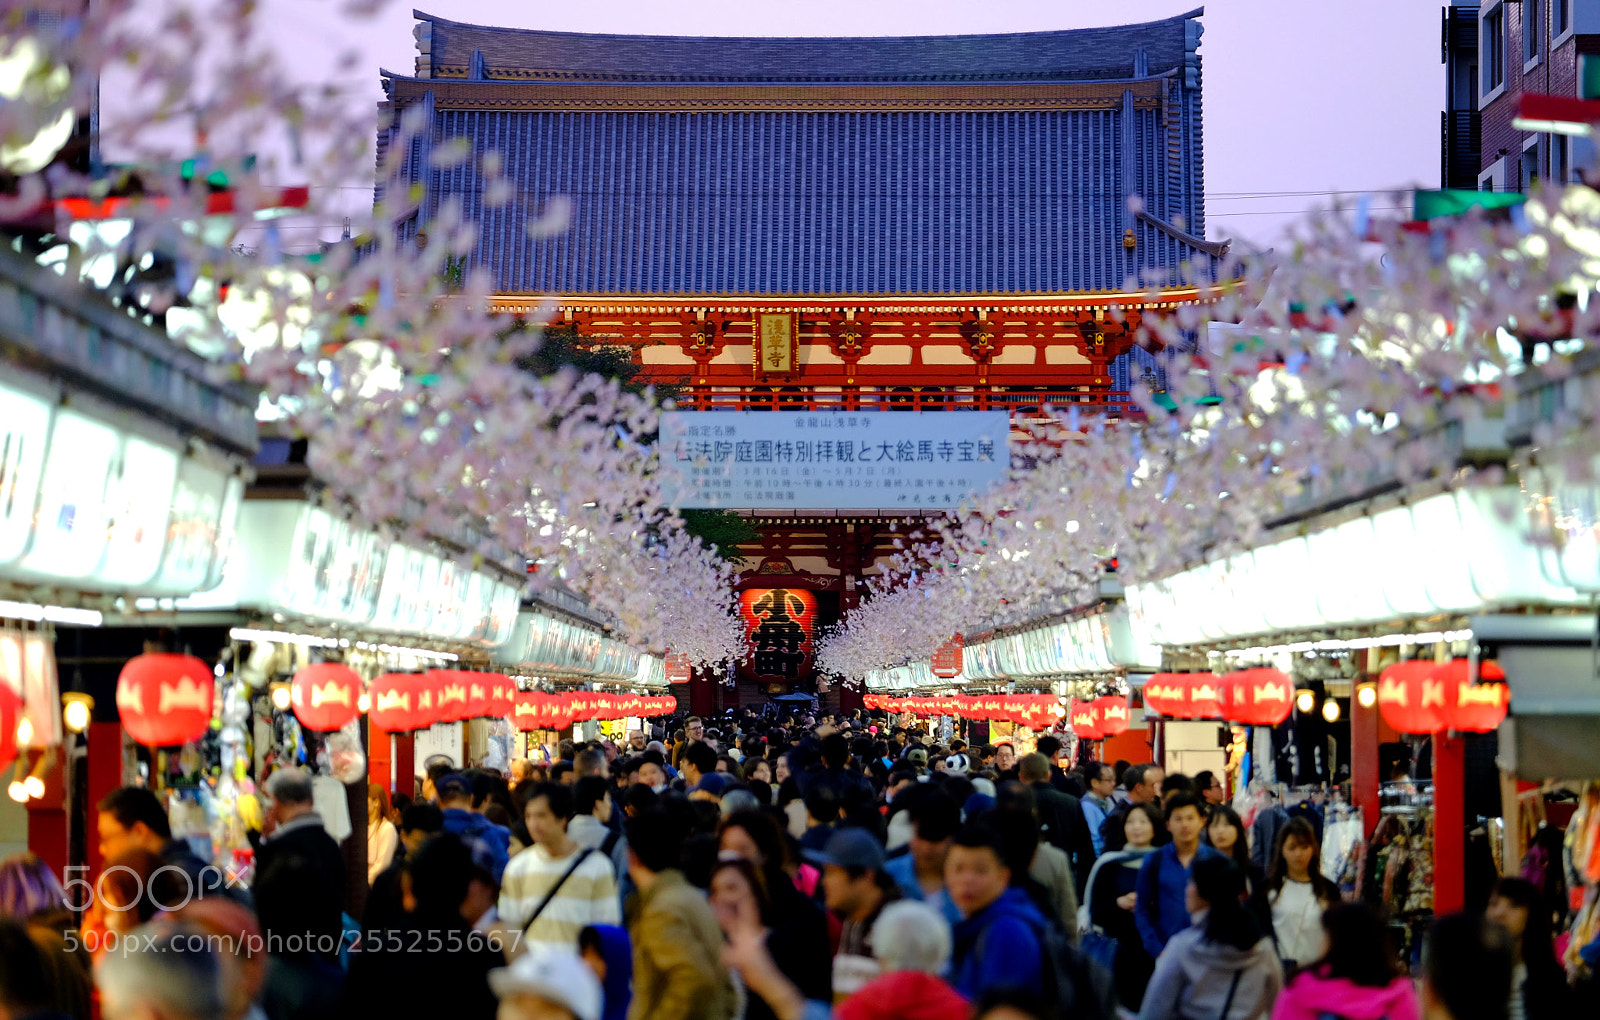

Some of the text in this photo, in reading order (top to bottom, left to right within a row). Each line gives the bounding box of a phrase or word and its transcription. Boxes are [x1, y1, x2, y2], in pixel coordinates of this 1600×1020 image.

[794, 416, 871, 429] 金龍山浅草寺
[678, 424, 736, 437] 指定名勝
[674, 439, 995, 462] 伝法院庭園特別拝観と大絵馬寺宝展
